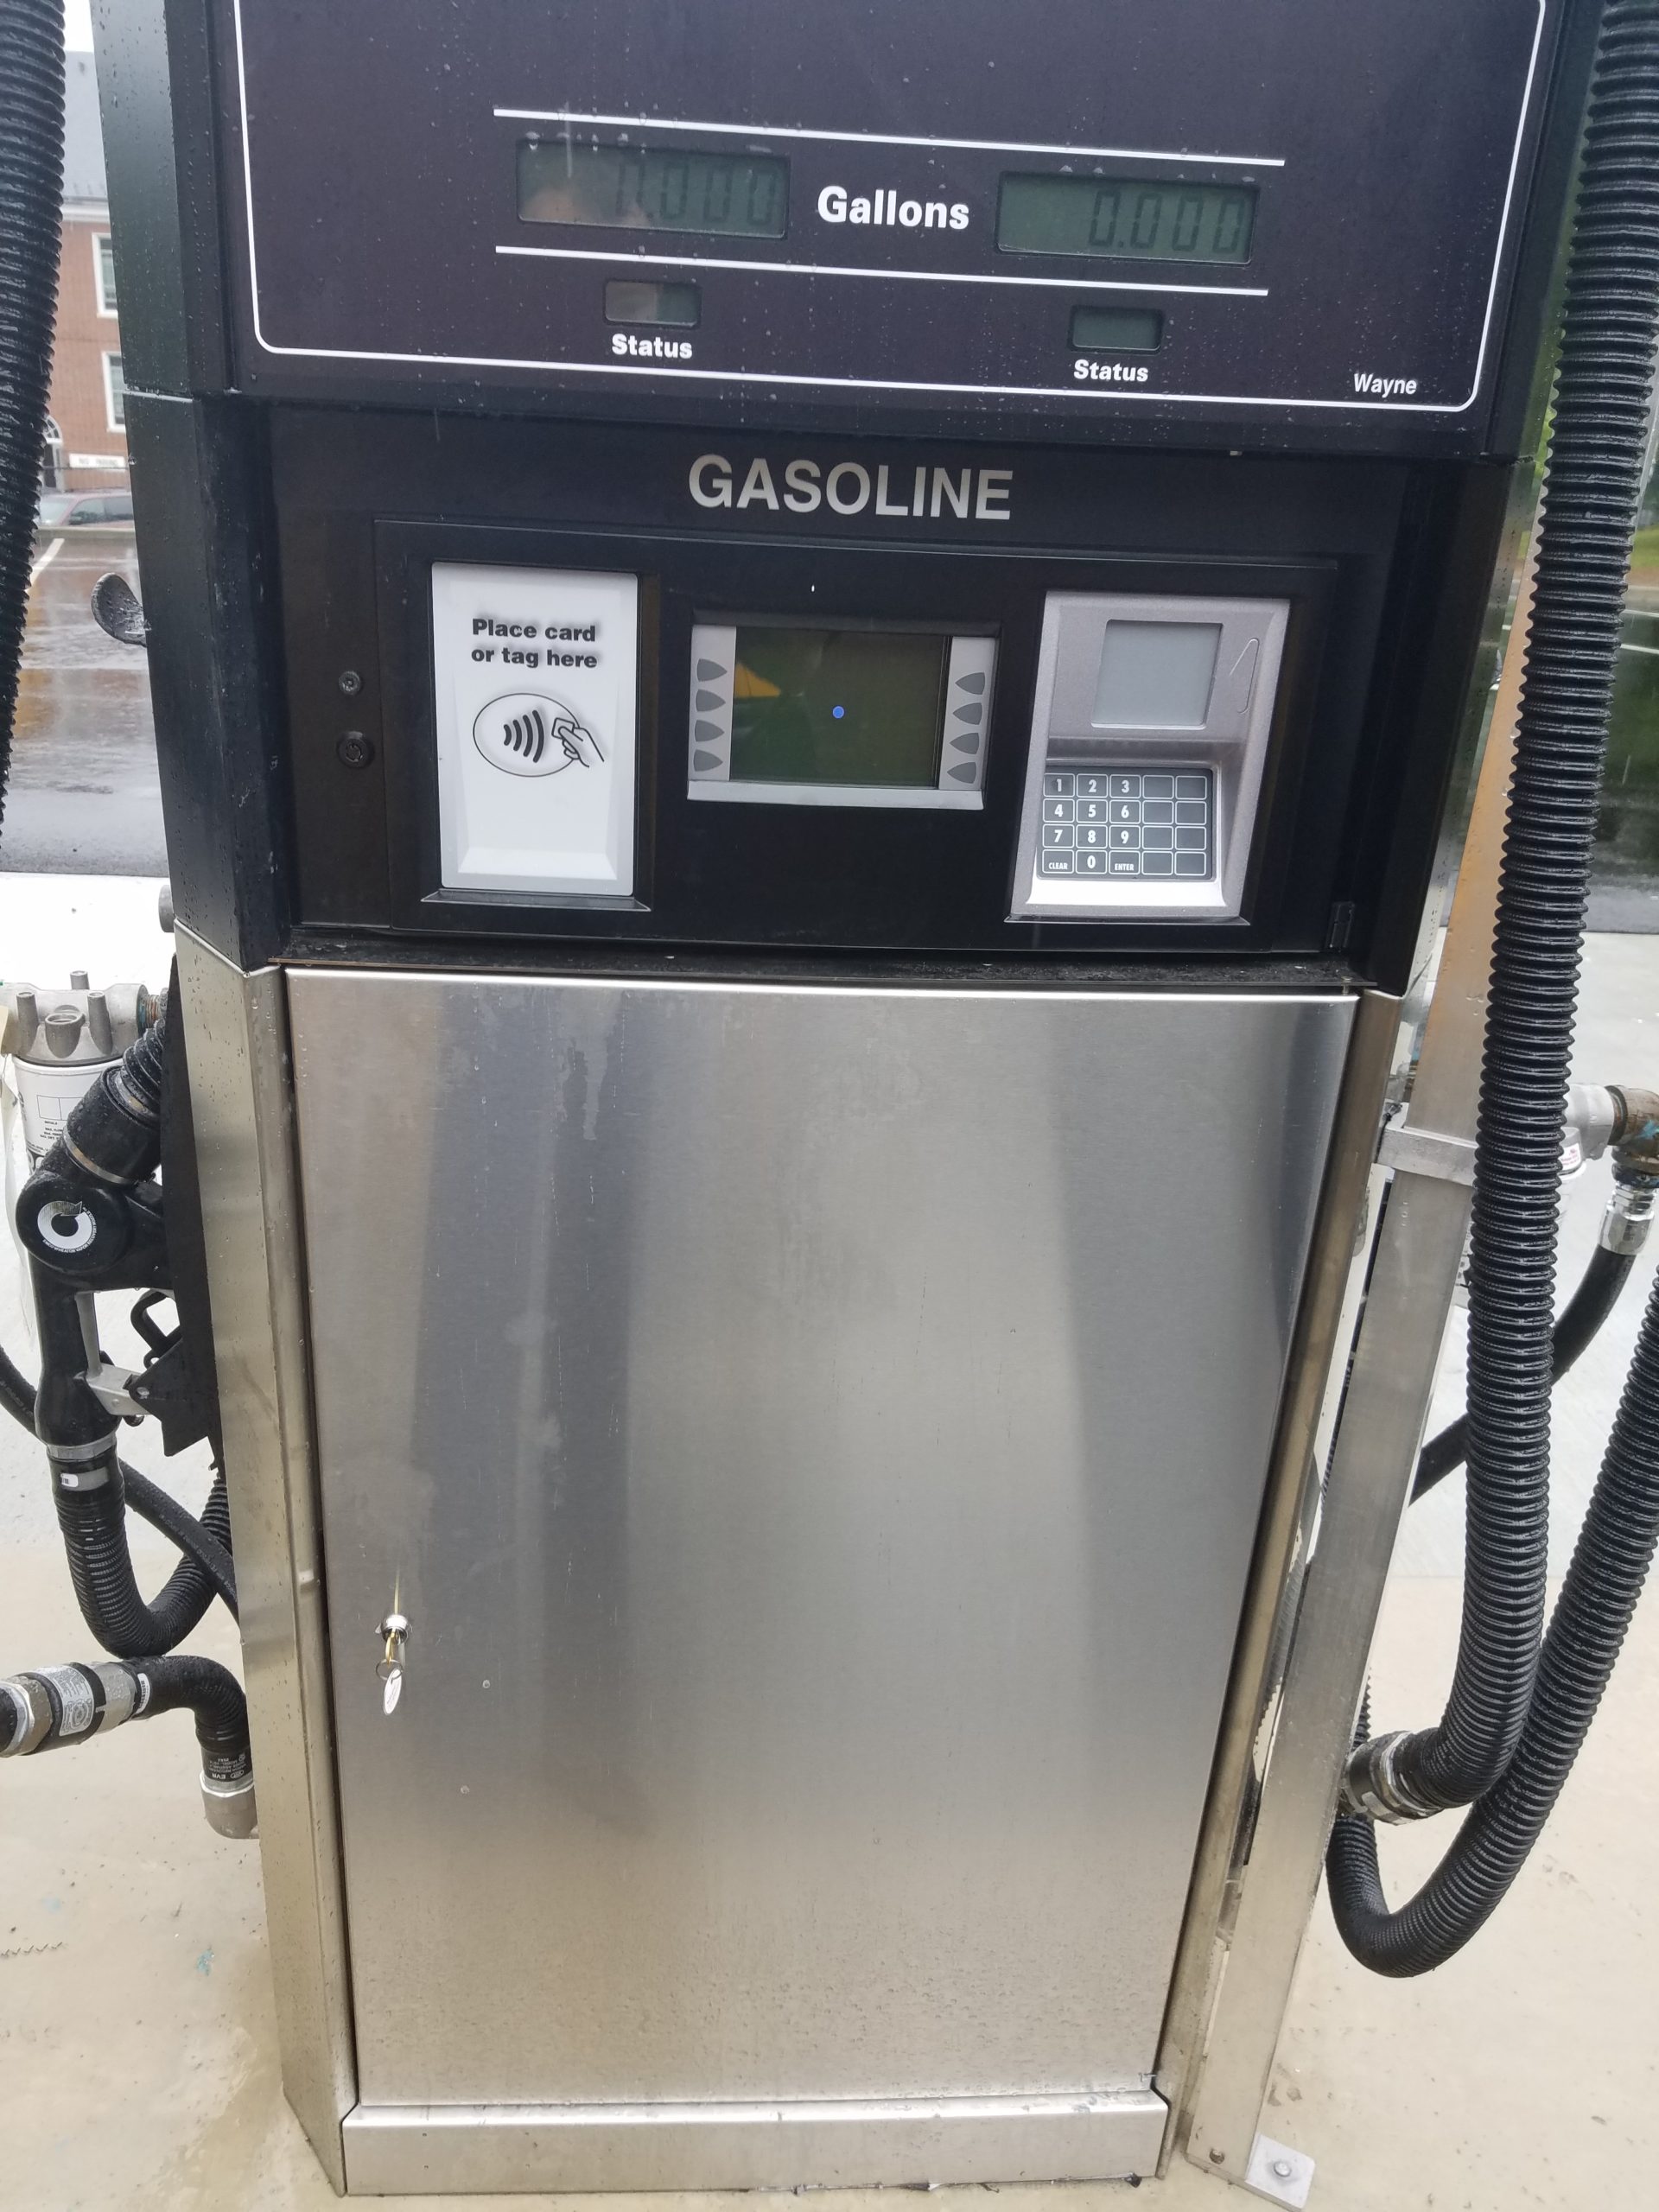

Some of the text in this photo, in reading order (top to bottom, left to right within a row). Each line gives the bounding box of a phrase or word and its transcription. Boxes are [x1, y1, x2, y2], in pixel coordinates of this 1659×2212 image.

[818, 186, 969, 229] Gallons
[1087, 188, 1246, 254] 0.000
[613, 334, 692, 359] Status
[1074, 359, 1147, 381] Status
[1354, 373, 1416, 397] Wayne
[690, 456, 1010, 519] GASOLINE
[472, 618, 596, 642] Place card
[471, 647, 598, 669] or tag here
[1055, 779, 1130, 793] 1 2 3
[1054, 804, 1129, 819] 4 5 6
[1054, 829, 1129, 844] 7 8 9
[1048, 861, 1068, 870] CLEAR
[1087, 855, 1096, 869] 0
